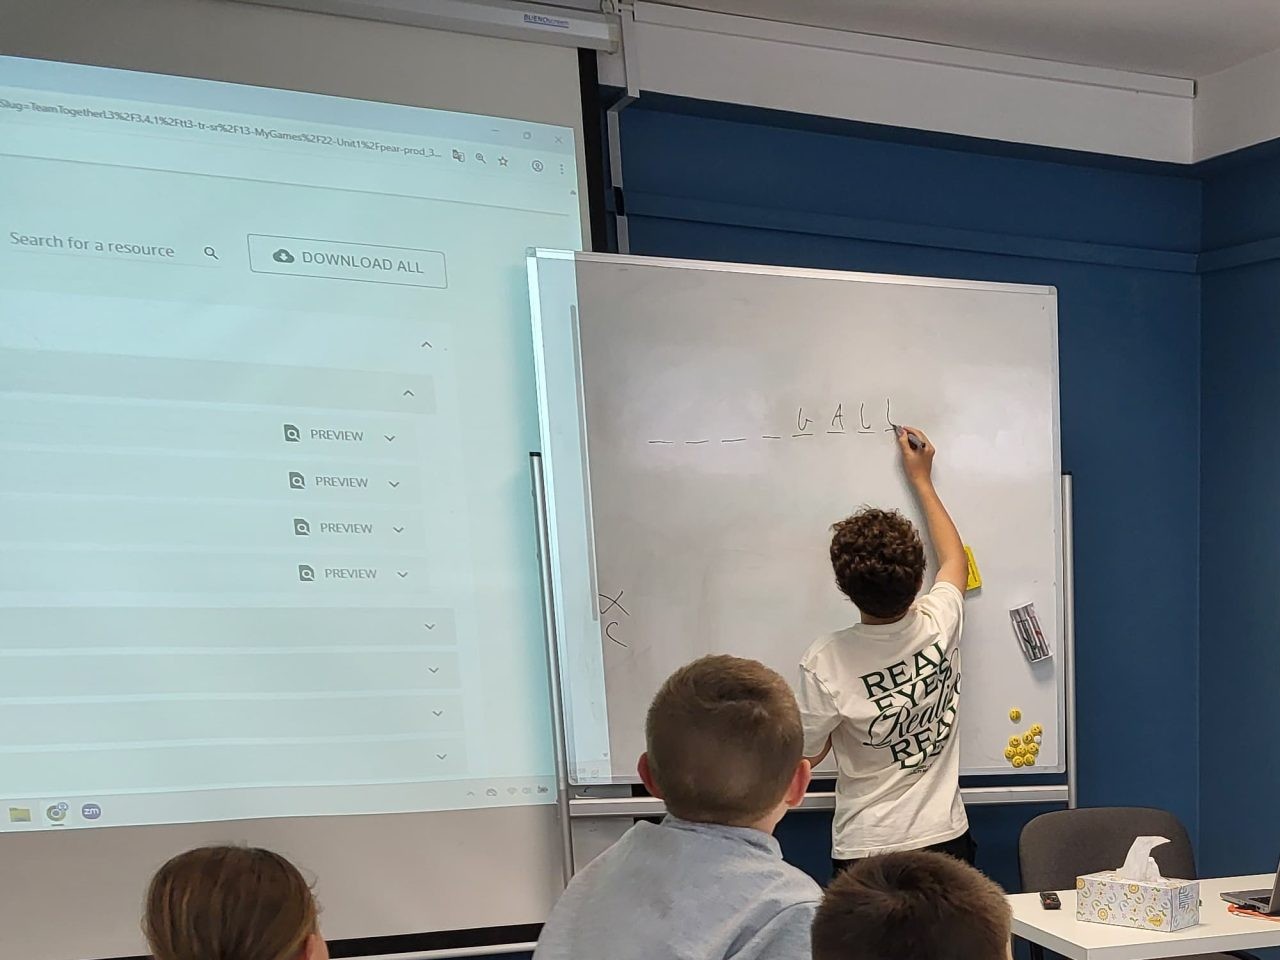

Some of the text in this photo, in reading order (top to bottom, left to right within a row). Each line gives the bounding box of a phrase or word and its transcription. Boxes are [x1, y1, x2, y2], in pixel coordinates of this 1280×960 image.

[10, 231, 175, 258] Search for a resource
[302, 251, 424, 274] DOWNLOAD ALL
[310, 429, 363, 441] PREVIEW
[315, 476, 368, 488] PREVIEW
[320, 522, 372, 534] PREVIEW
[325, 568, 377, 579] PREVIEW
